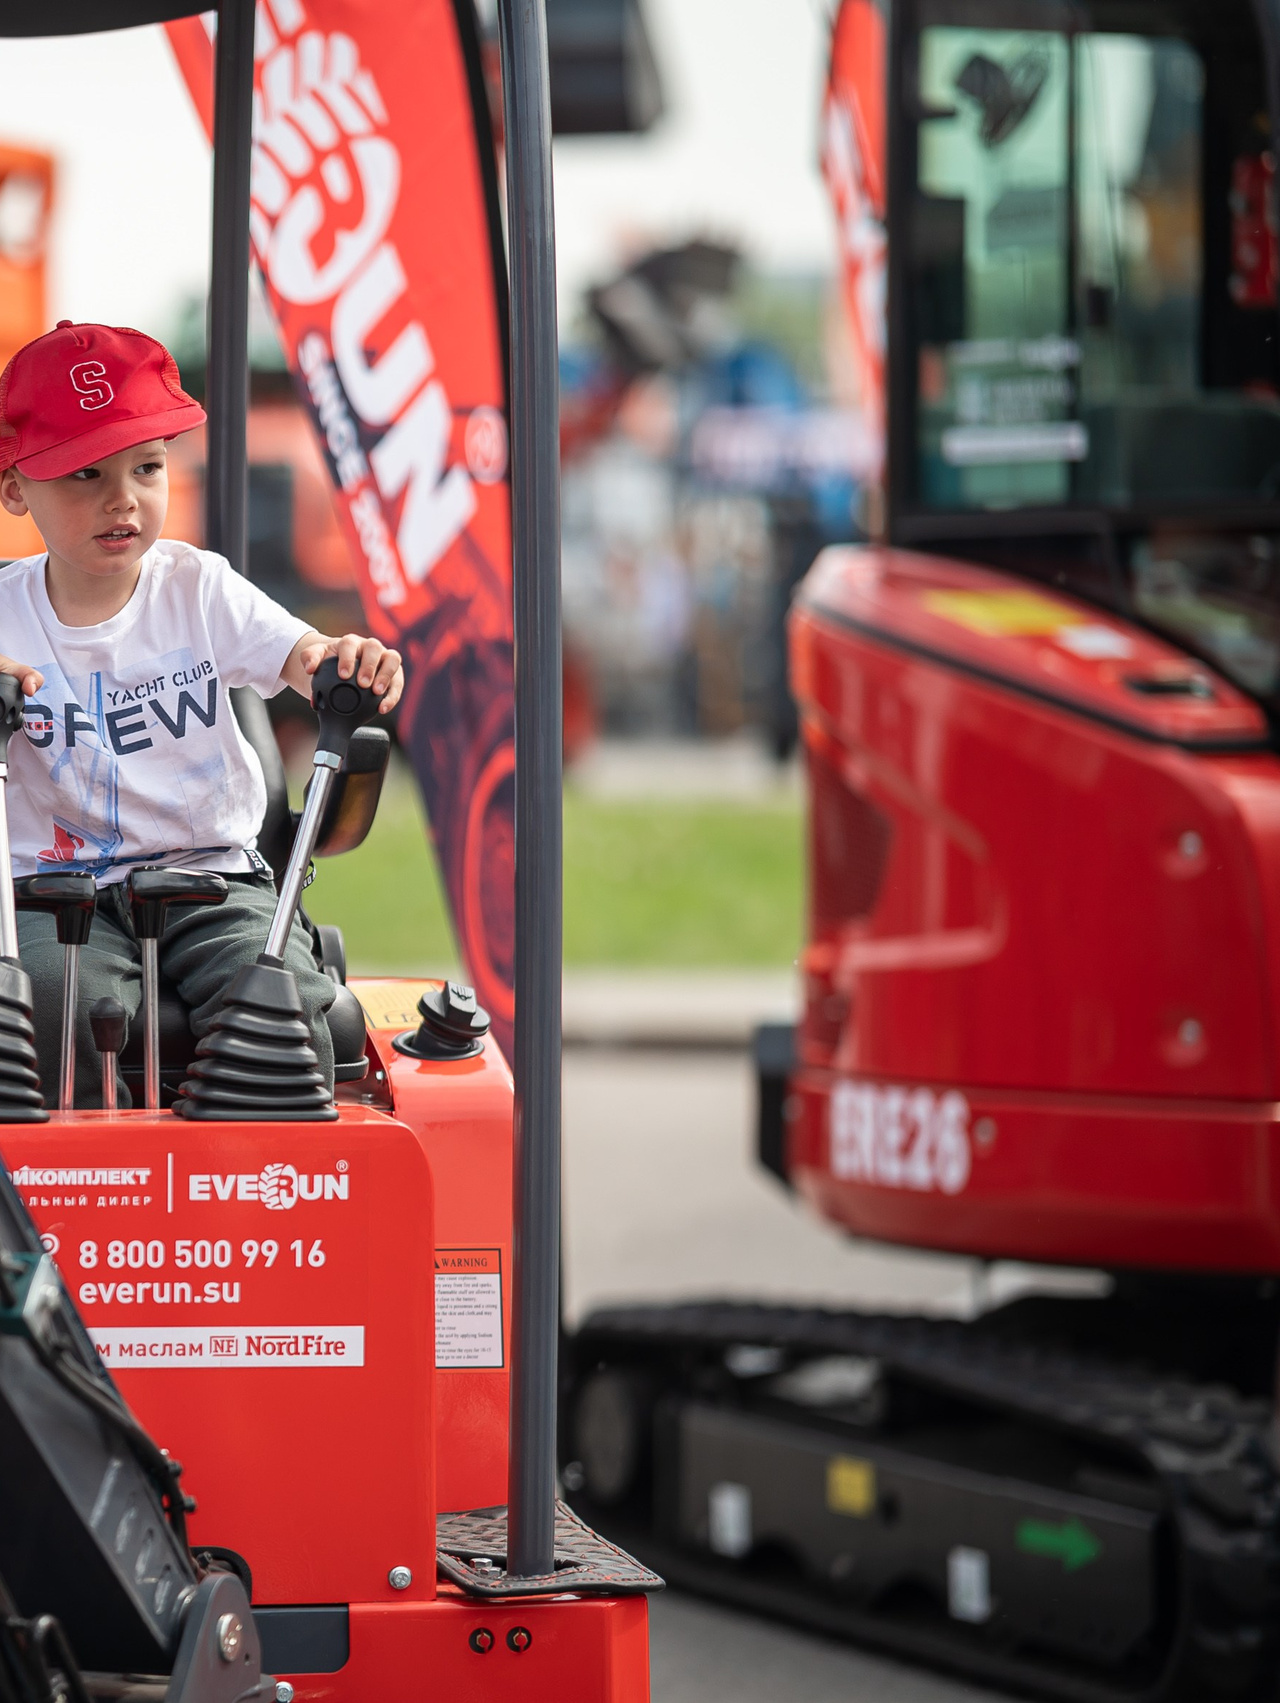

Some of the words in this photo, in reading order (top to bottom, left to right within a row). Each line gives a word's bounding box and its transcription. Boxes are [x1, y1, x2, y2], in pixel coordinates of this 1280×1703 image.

[70, 361, 114, 410] S
[106, 676, 166, 706] YACHT
[172, 660, 214, 688] CLUB
[831, 1081, 971, 1196] ERE26
[188, 1163, 349, 1210] EVERUN
[96, 1196, 152, 1207] ДИЛЕР
[79, 1240, 98, 1268] 8
[107, 1240, 164, 1268] 800
[174, 1240, 232, 1268] 500
[241, 1240, 279, 1268] 99
[290, 1240, 326, 1268] 16
[442, 1258, 488, 1267] WARNING
[79, 1281, 241, 1304] everun.su
[118, 1344, 203, 1356] маслам
[244, 1335, 346, 1356] NordFire
